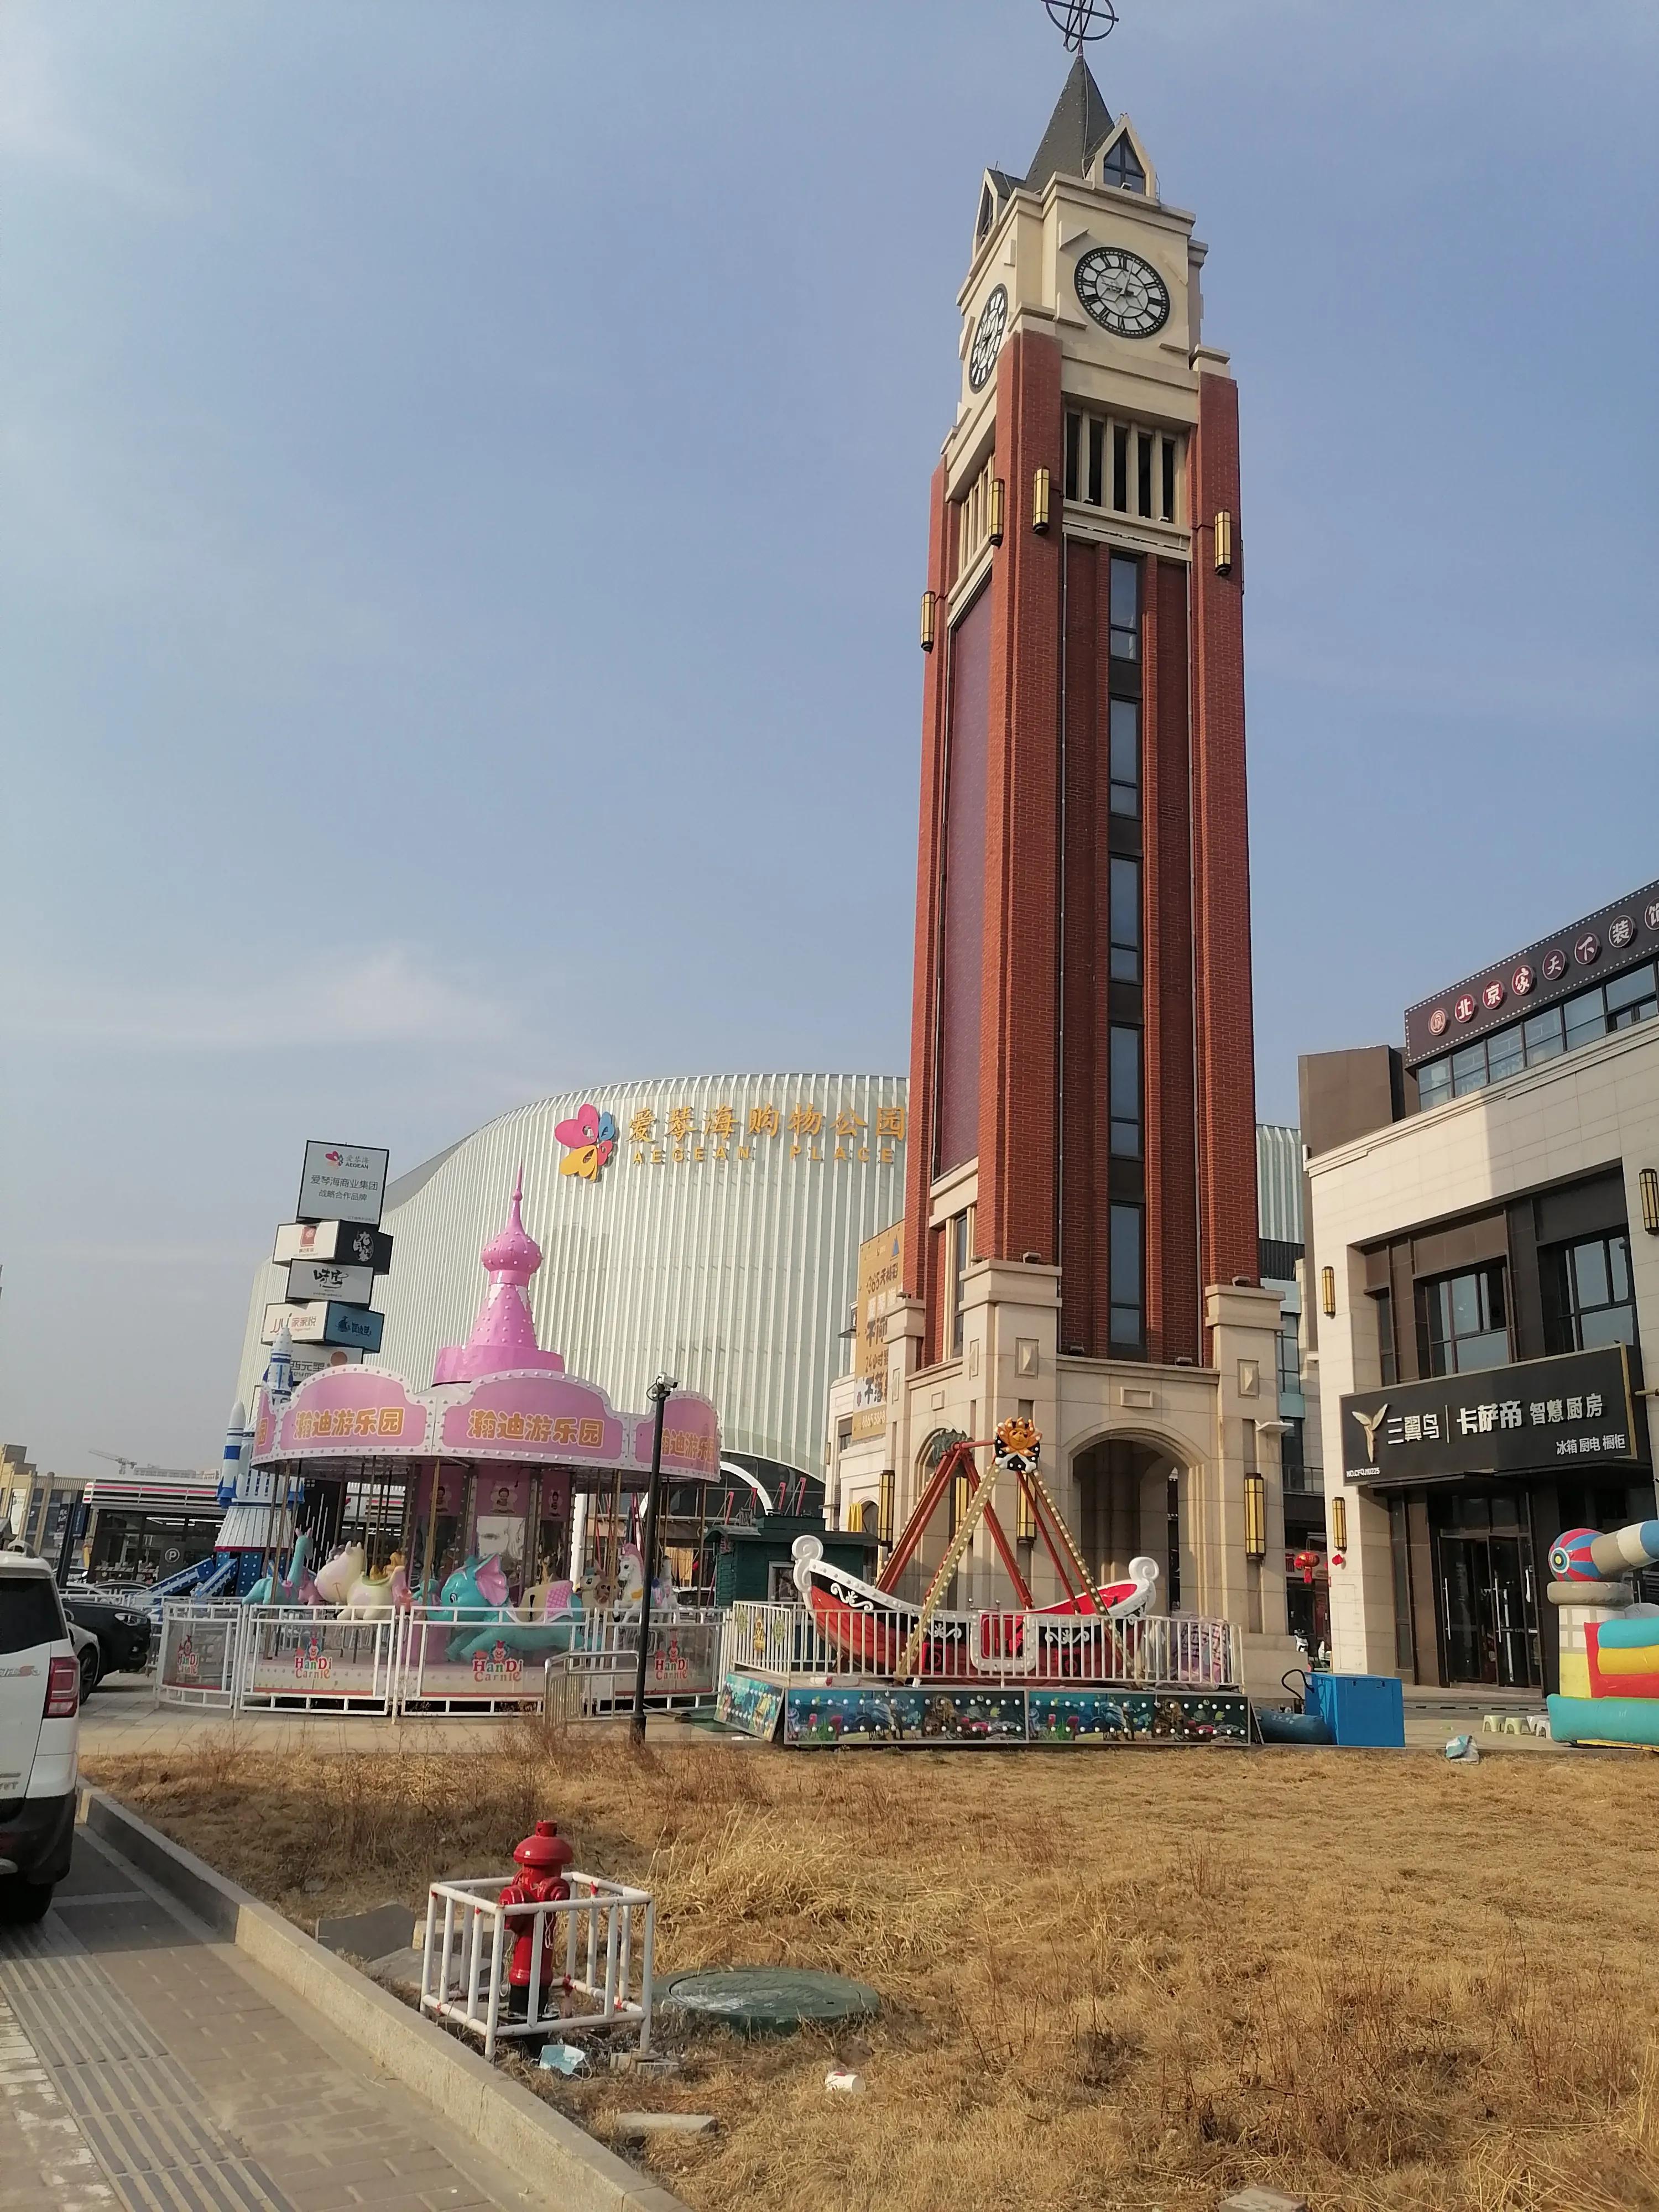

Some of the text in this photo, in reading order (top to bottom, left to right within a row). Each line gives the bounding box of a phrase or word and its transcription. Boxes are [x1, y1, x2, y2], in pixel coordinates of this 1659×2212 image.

[627, 1102, 905, 1143] 爱琴海购物公园
[633, 1145, 894, 1164] AEGEAN PLACE
[310, 1175, 378, 1191] 爱琴海商业集团
[319, 1190, 367, 1201] 战略合作品牌
[293, 1407, 405, 1439] 瀚迪游乐园
[1387, 1392, 1603, 1444] 三翼鸟 卡萨帝 智慧厨房
[466, 1408, 604, 1449] 瀚迪游乐园
[1556, 1434, 1626, 1455] 冰箱 厨电 橱柜
[295, 1657, 332, 1670] HanDi
[473, 1660, 523, 1672] HanDi
[655, 1659, 688, 1670] HanDi
